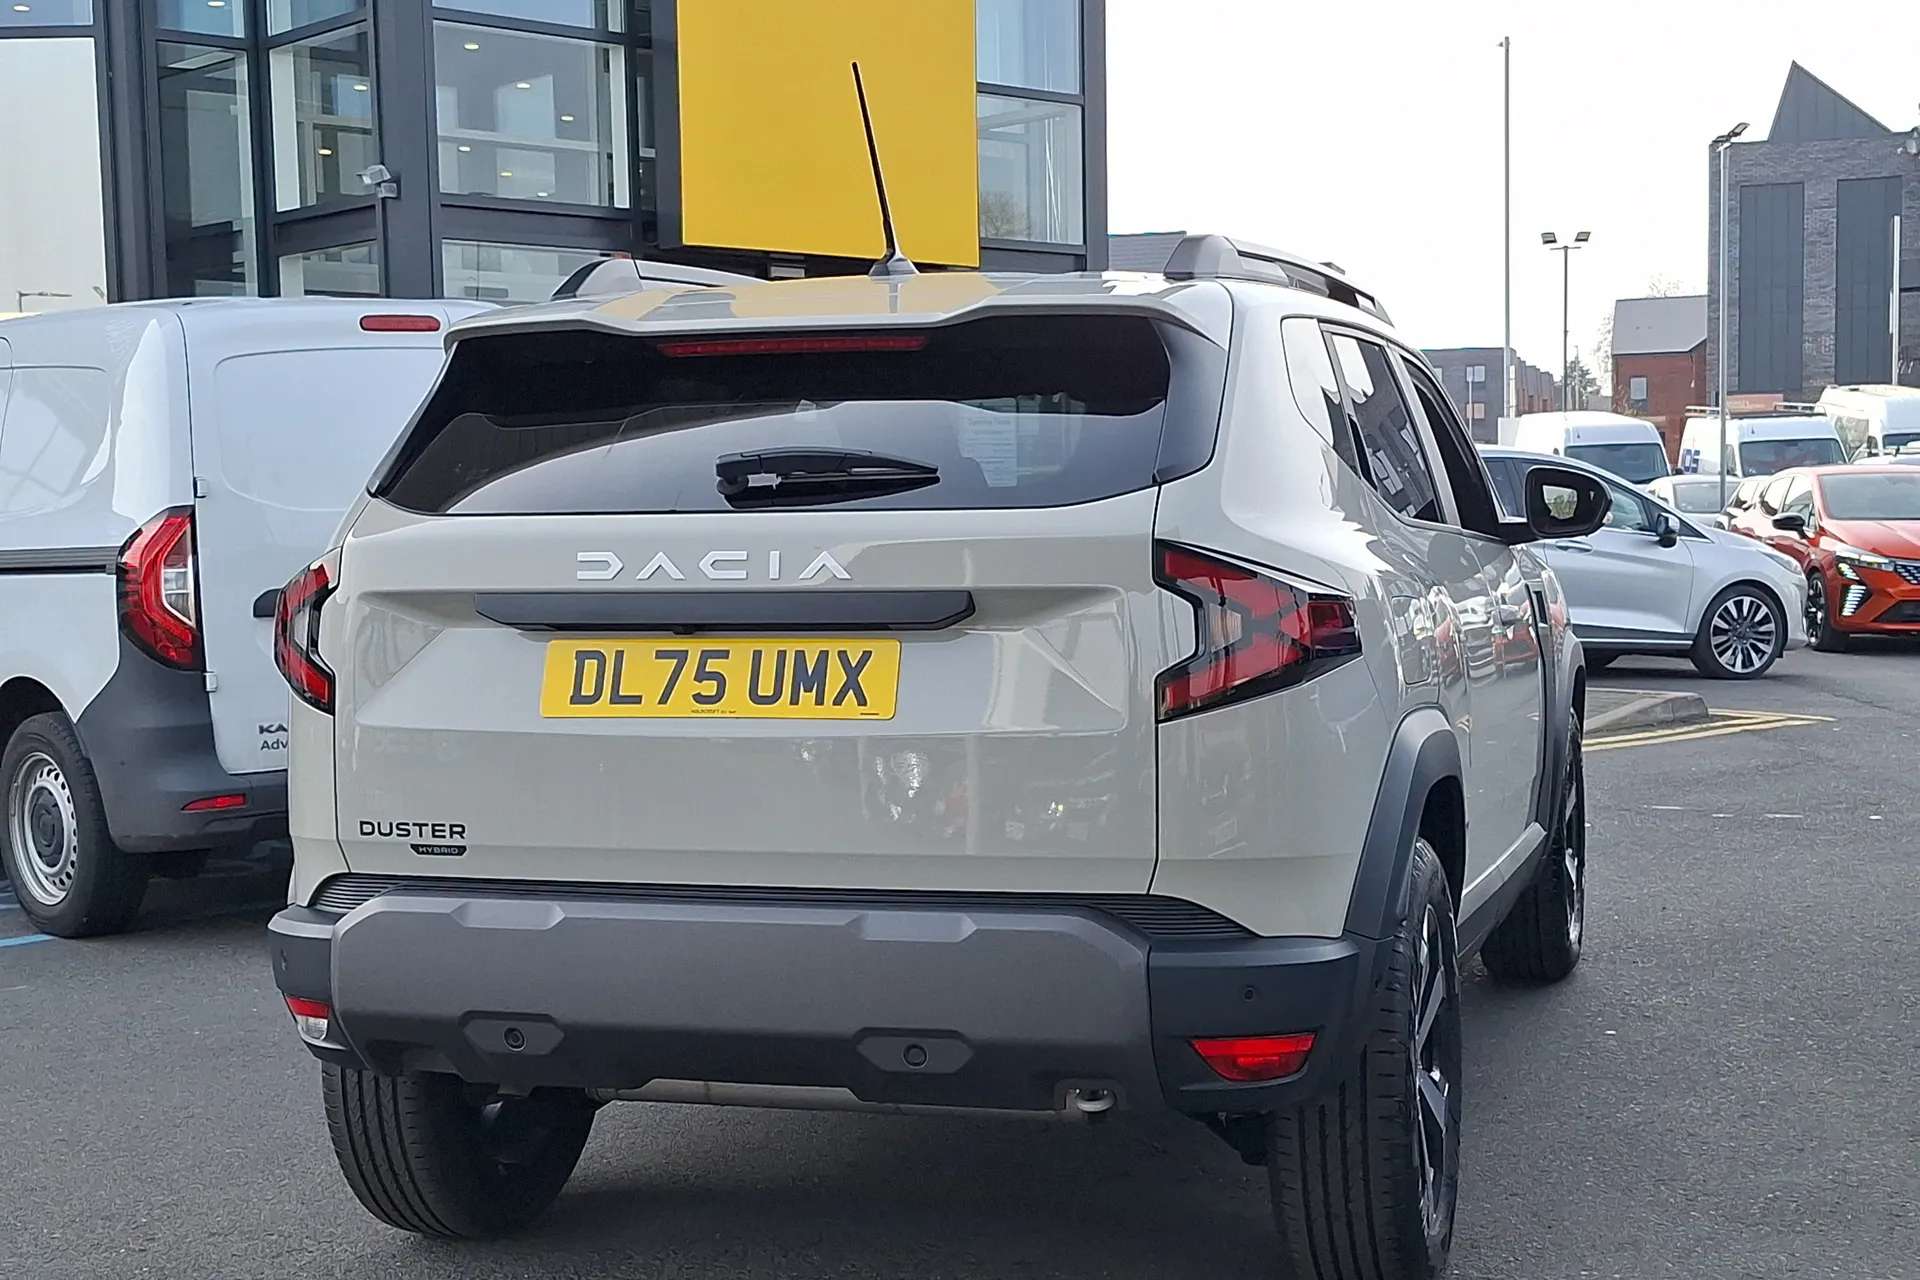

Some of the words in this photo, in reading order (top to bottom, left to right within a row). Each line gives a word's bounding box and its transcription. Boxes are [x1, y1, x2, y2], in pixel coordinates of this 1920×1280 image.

[576, 550, 852, 580] DACIA
[569, 649, 730, 706] DL75
[746, 649, 873, 707] UMX
[260, 738, 288, 751] Adv
[359, 820, 466, 839] DUSTER
[418, 846, 459, 855] HYBRID
